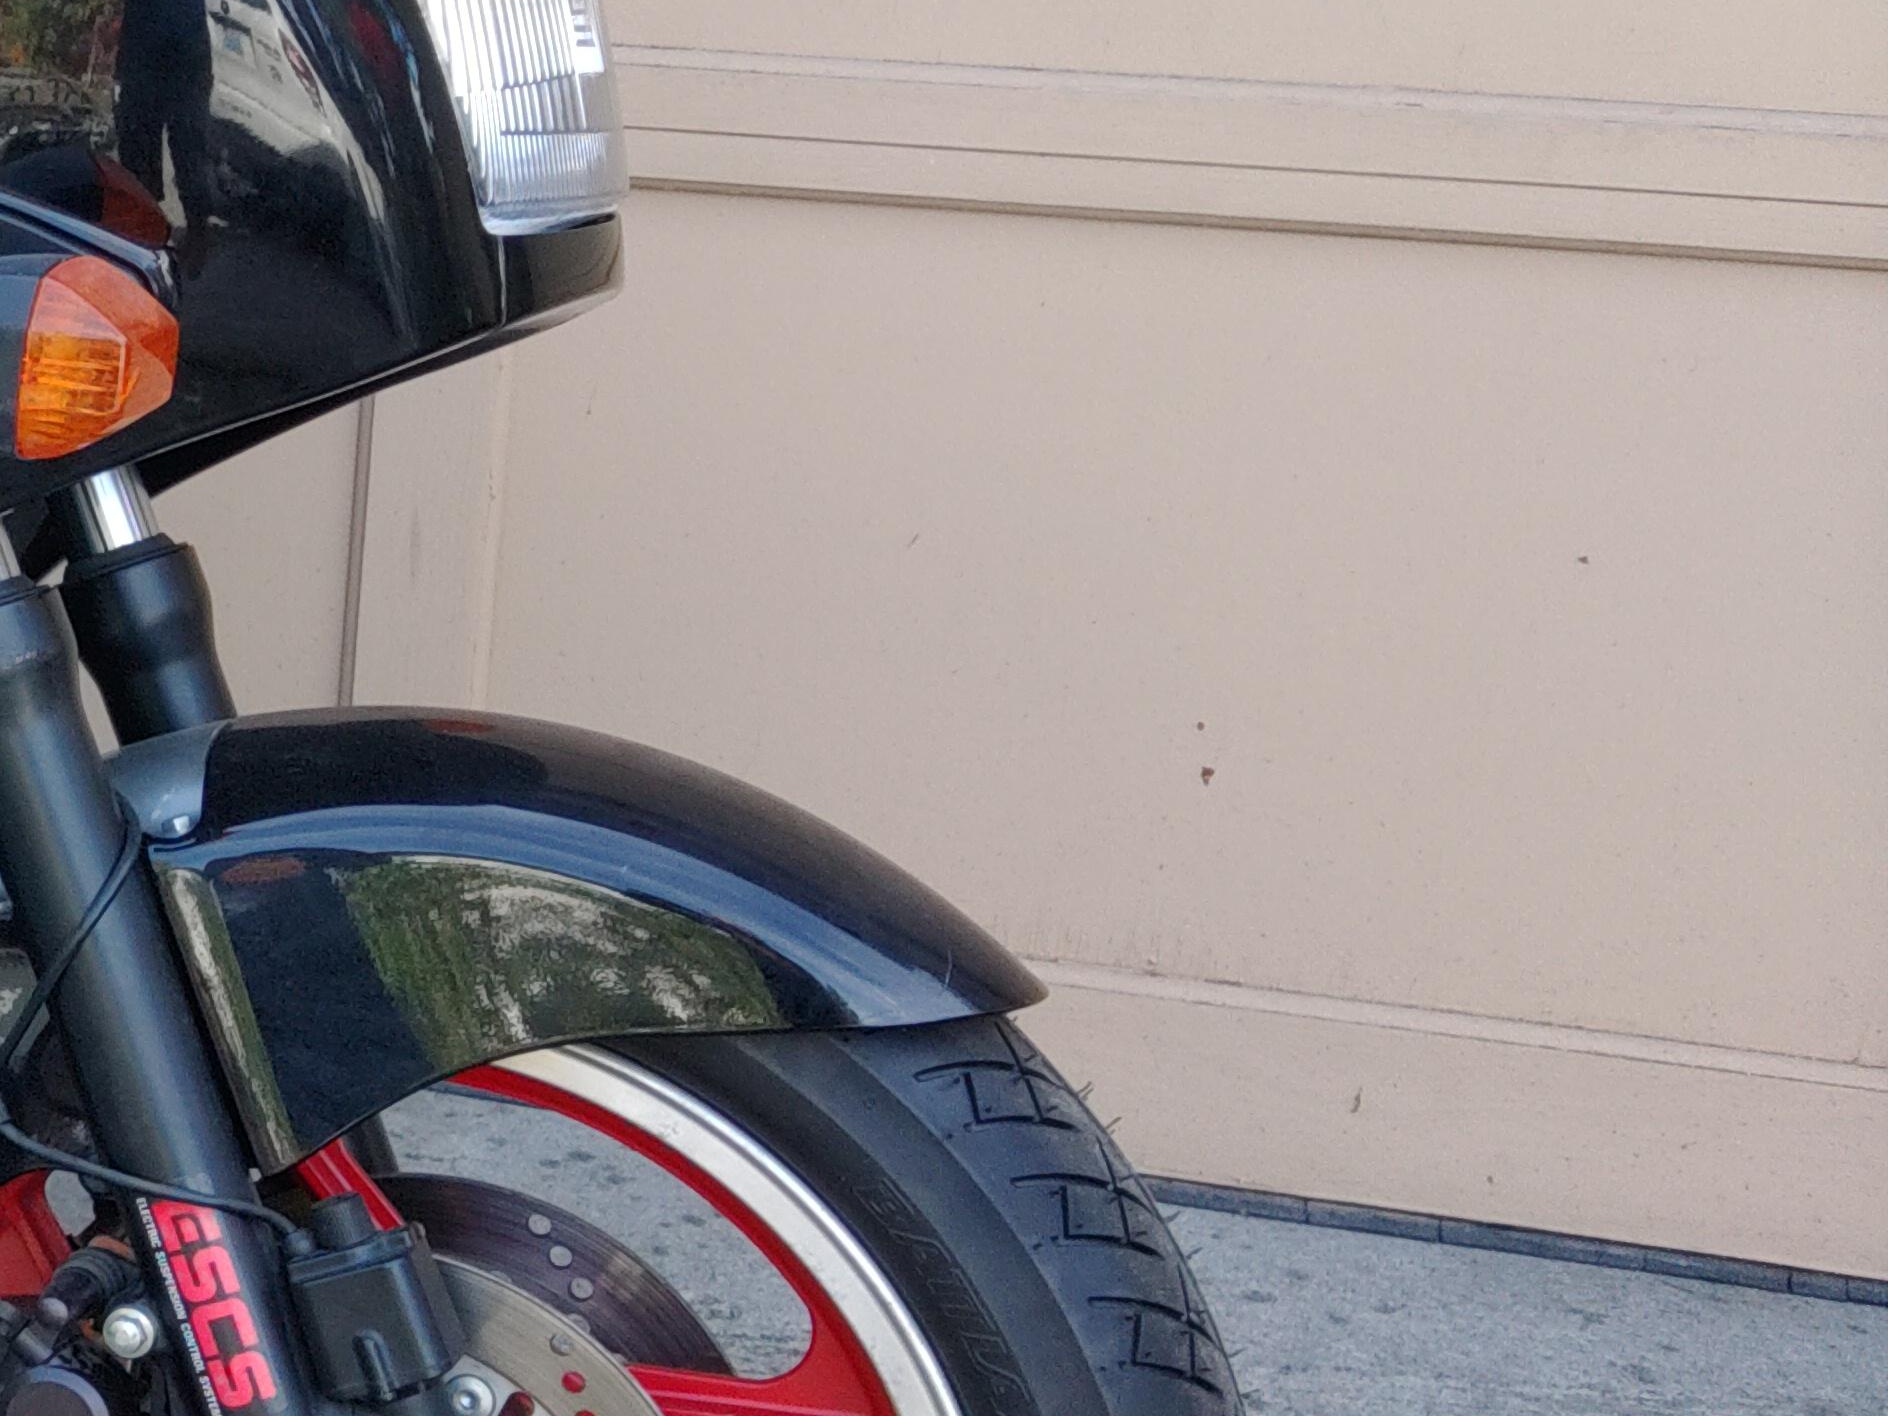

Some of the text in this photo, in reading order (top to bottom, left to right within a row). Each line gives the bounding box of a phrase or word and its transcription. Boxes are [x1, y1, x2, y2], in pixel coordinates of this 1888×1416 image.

[136, 1197, 162, 1249] ELECTRIC
[154, 1250, 187, 1320] SUSPENSION
[180, 1322, 206, 1374] CONTROL
[151, 1199, 277, 1411] ESCS
